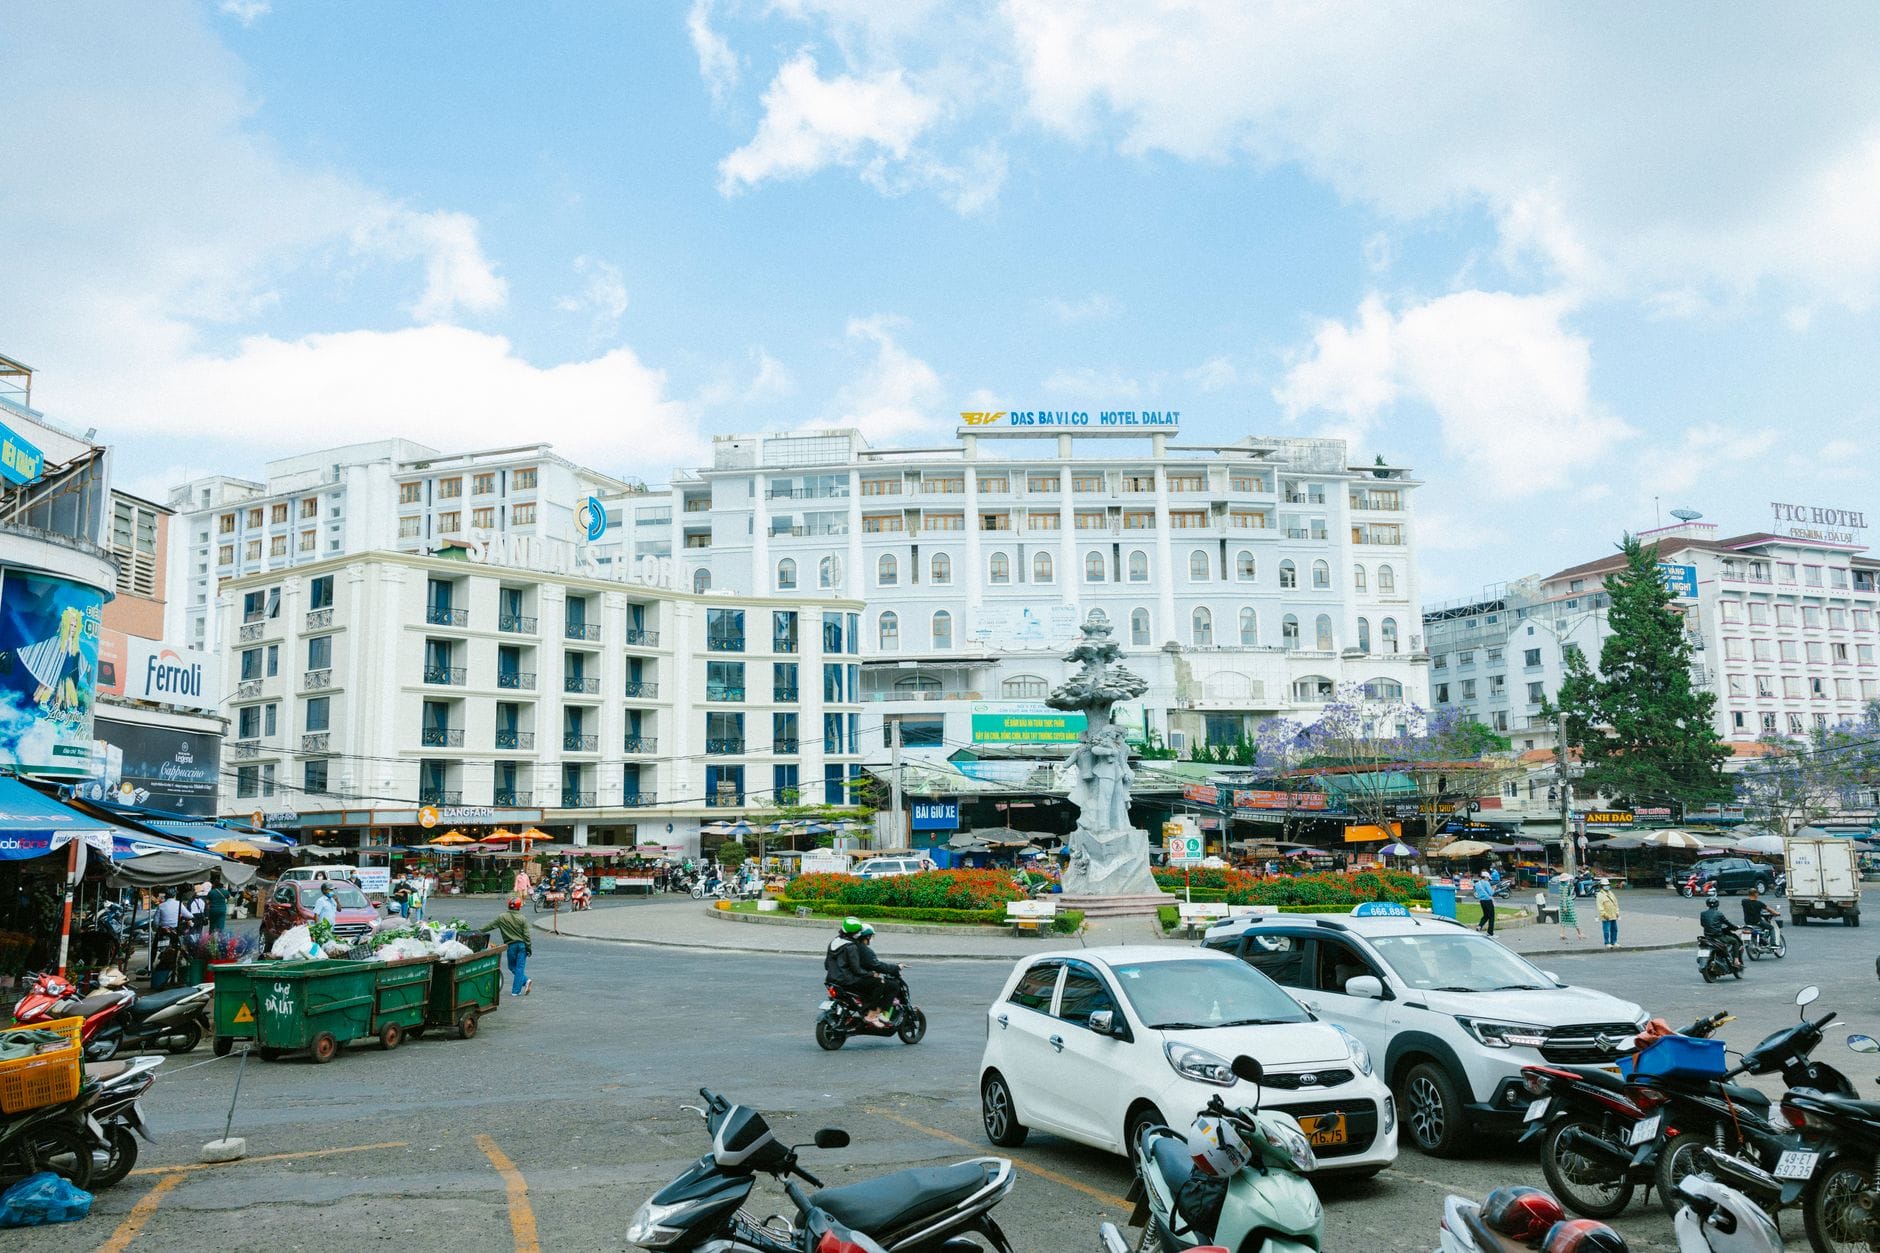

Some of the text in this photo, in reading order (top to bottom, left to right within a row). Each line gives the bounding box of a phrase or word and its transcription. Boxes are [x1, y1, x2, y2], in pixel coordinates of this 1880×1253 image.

[1010, 411, 1180, 425] DAS BAVICO HOTEL DALAT
[1771, 502, 1868, 529] TTC HOTEL
[465, 526, 602, 578] SANDALS
[145, 654, 201, 697] Ferroli
[175, 754, 193, 764] Legend
[161, 761, 205, 780] Cappuccino
[945, 805, 956, 819] XE
[1587, 814, 1610, 822] ANH
[0, 837, 49, 850] obifone
